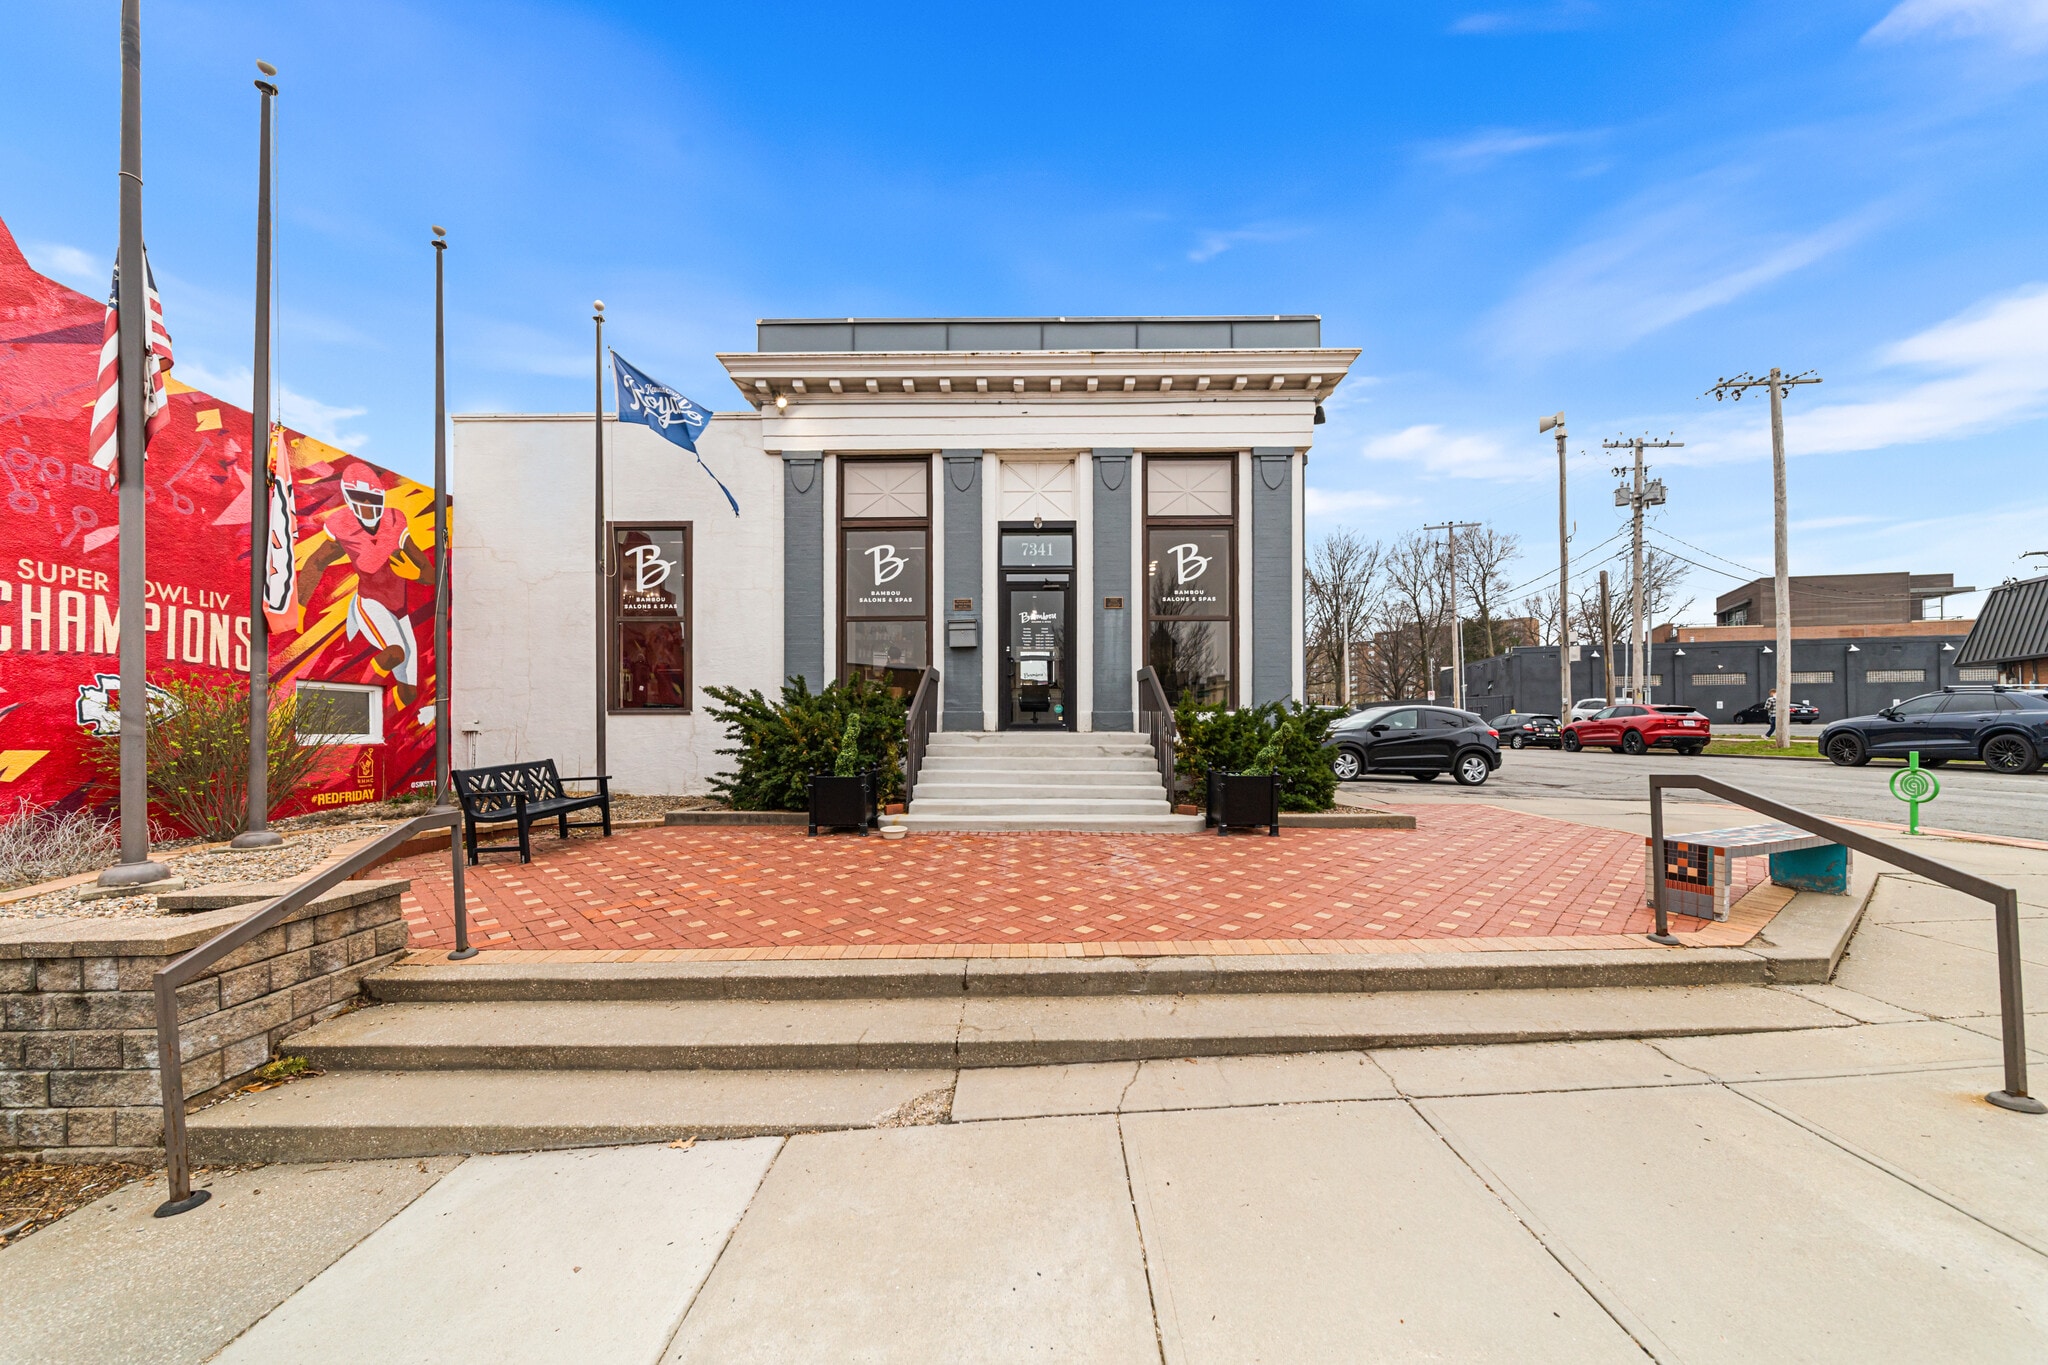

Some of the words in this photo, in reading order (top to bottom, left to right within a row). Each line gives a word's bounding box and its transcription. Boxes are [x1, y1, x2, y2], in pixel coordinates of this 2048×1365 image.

[625, 544, 677, 592] B
[864, 544, 909, 586] B
[1021, 542, 1054, 556] 7341
[1166, 543, 1213, 585] B
[17, 558, 110, 592] SUPER
[145, 579, 193, 605] OWL
[199, 588, 231, 611] LIV
[311, 788, 376, 806] #REDFRIDAY
